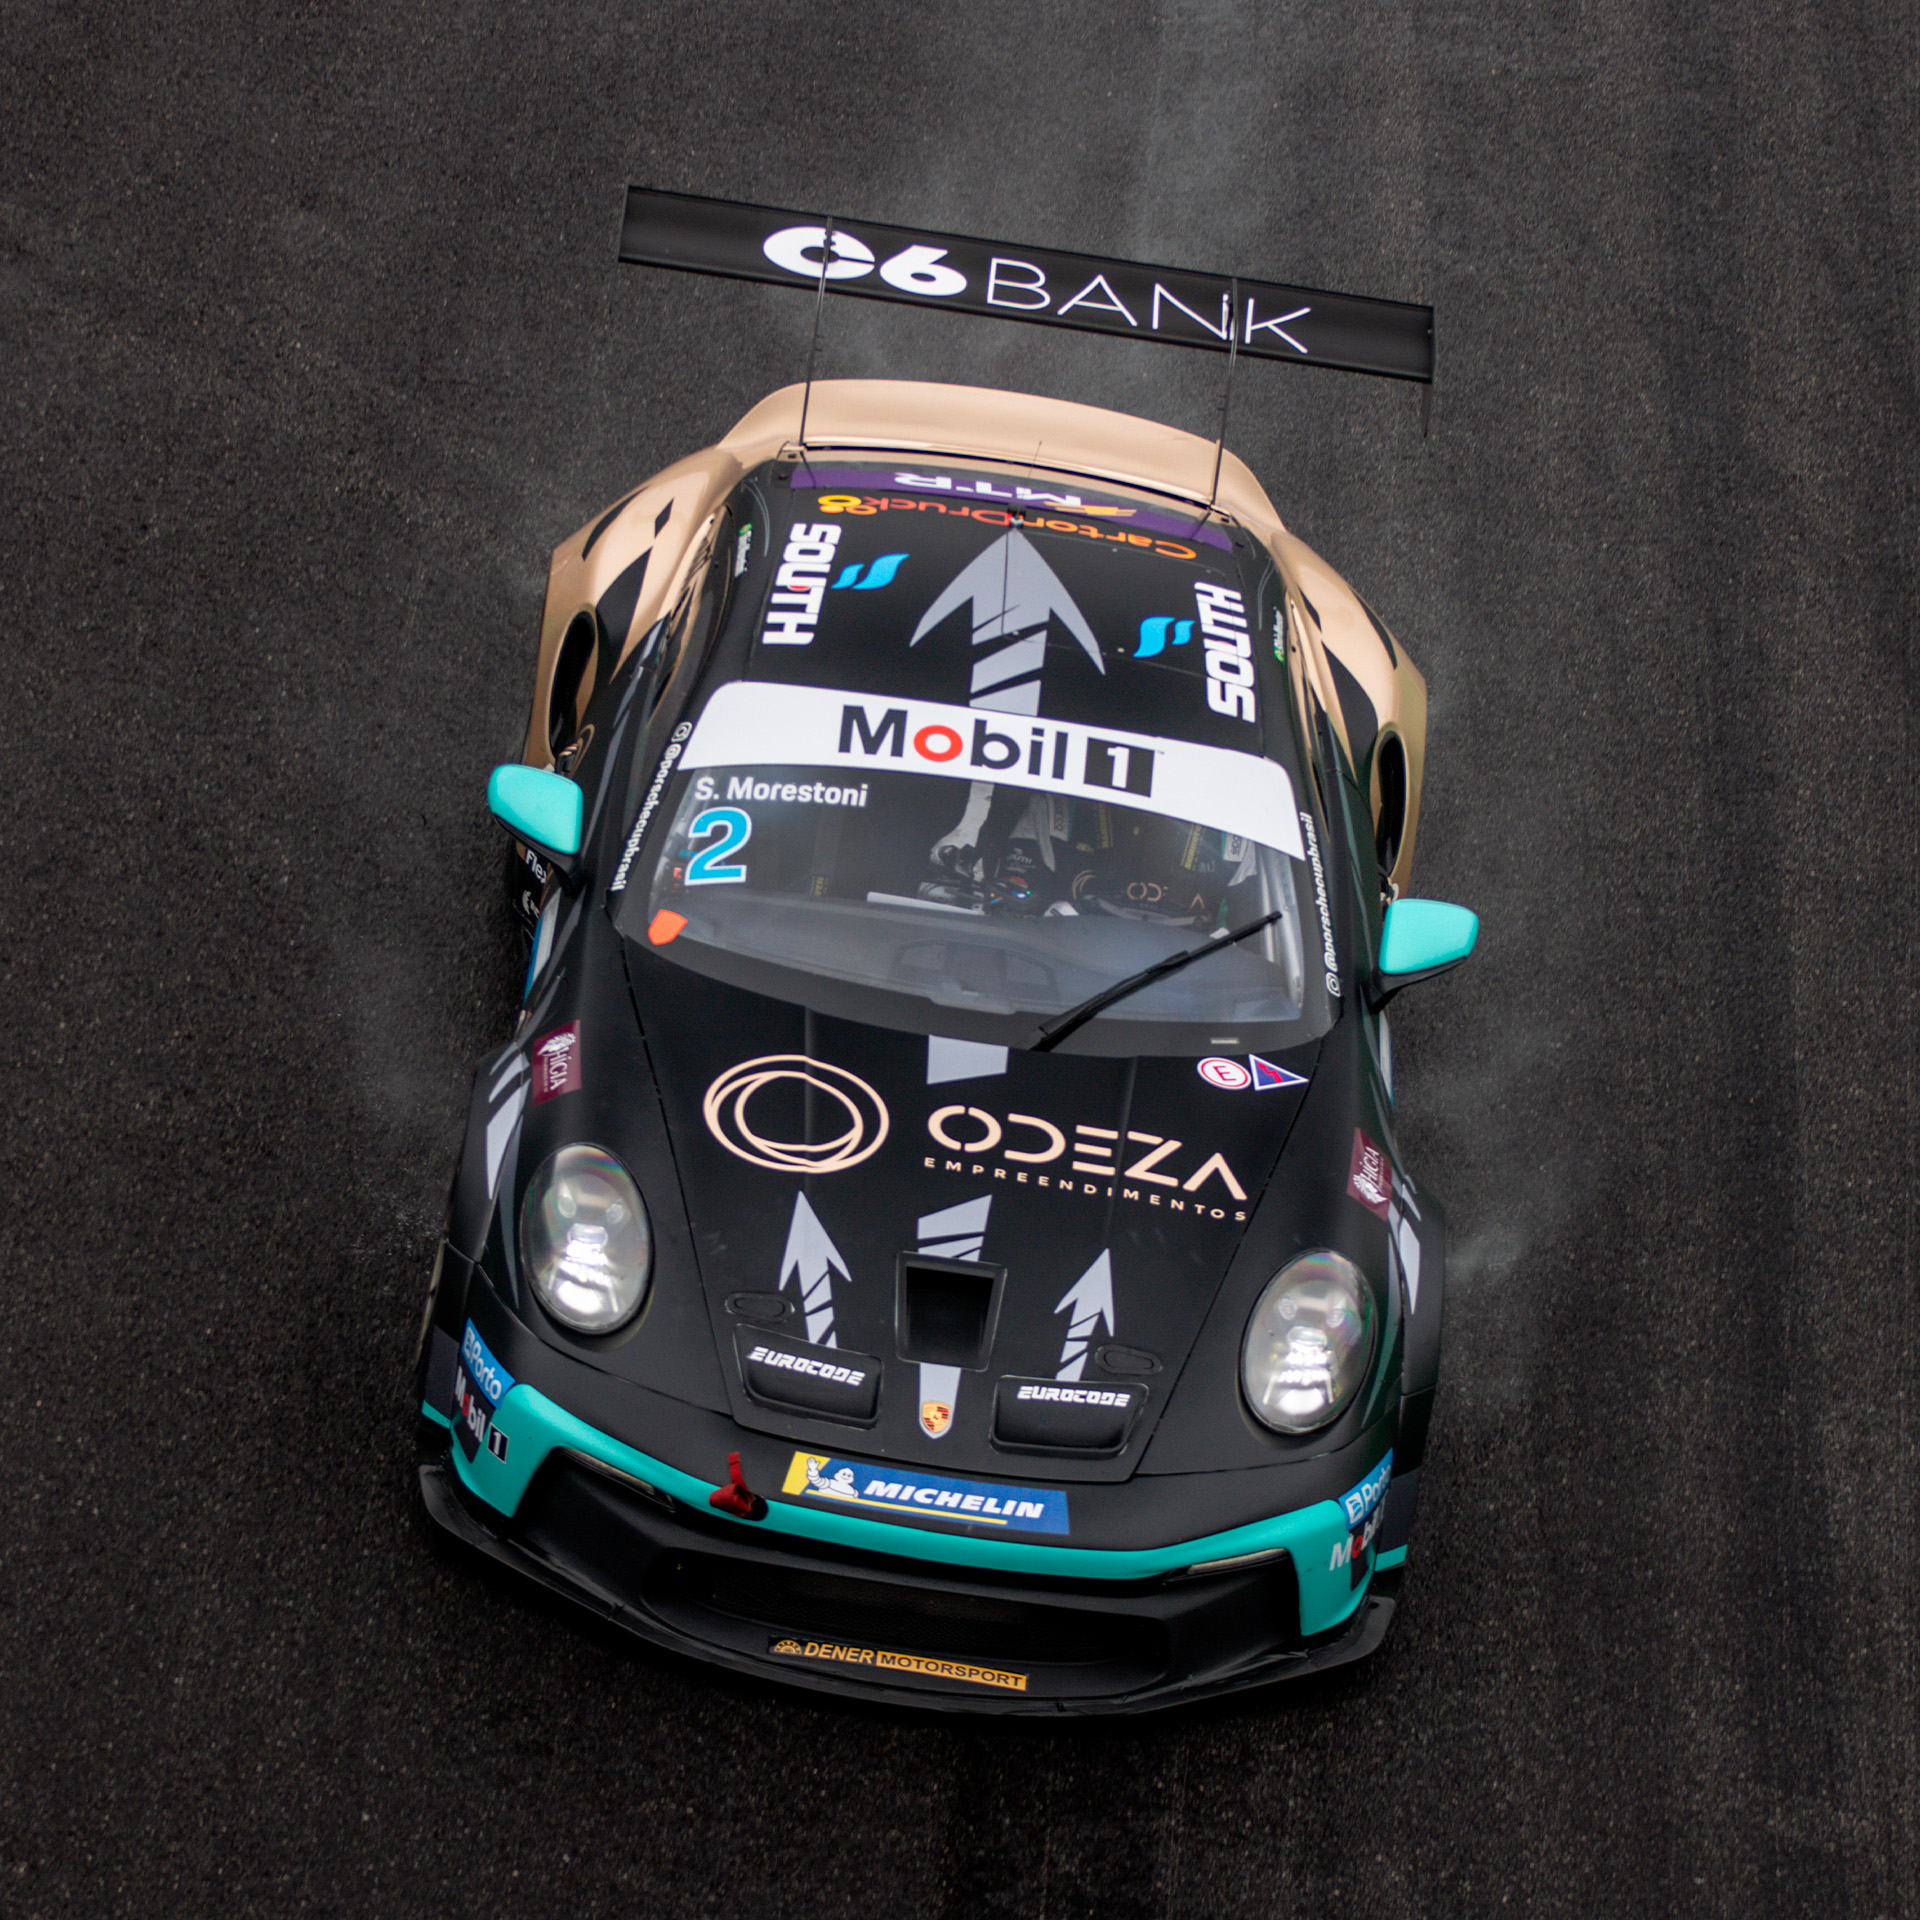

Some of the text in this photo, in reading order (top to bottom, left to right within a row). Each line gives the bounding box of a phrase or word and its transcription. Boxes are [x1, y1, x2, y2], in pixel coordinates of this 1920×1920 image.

[764, 226, 1311, 354] C6 BANK
[762, 523, 842, 645] SOUTH
[1194, 581, 1256, 723] SOUTH
[838, 704, 1069, 782] Mobil
[611, 743, 682, 891] @porschecupbrasil
[694, 776, 869, 808] S. Morestoni
[684, 806, 752, 887] 2
[1299, 811, 1339, 973] @porschecupbrasil
[1212, 1065, 1237, 1082] E
[924, 1156, 1247, 1221] EMPREENDIMENTOS
[927, 1104, 1248, 1200] ODEZA
[455, 1365, 486, 1443] Mobil
[470, 1340, 502, 1400] Porto
[747, 1346, 866, 1386] EUROCODE
[1017, 1385, 1131, 1408] EUROCODE
[863, 1479, 1045, 1520] MICHELIN
[803, 1641, 1024, 1688] DENER MOTORSPORT
